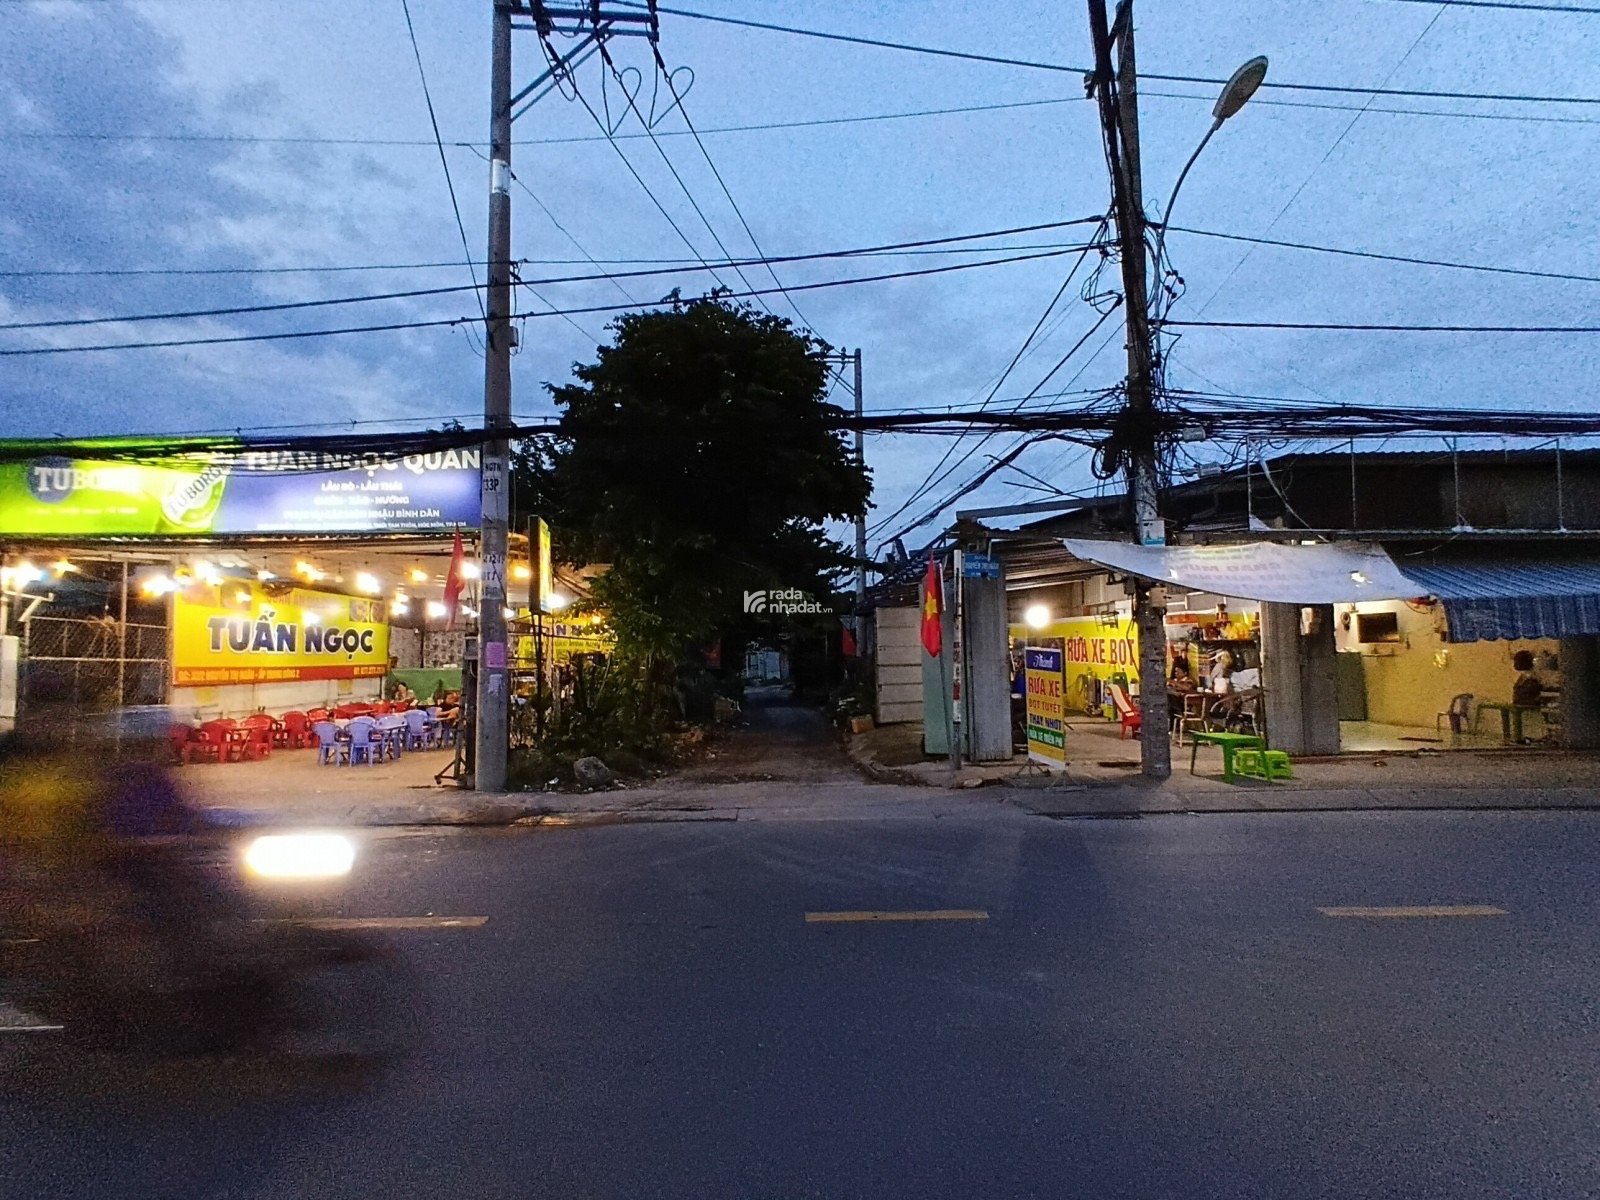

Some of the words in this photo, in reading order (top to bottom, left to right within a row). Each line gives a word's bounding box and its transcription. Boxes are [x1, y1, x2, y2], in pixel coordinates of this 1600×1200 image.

[208, 611, 296, 653] TUẤN
[304, 624, 374, 659] NGỌC
[1092, 638, 1106, 664] XE
[1049, 680, 1061, 697] XE
